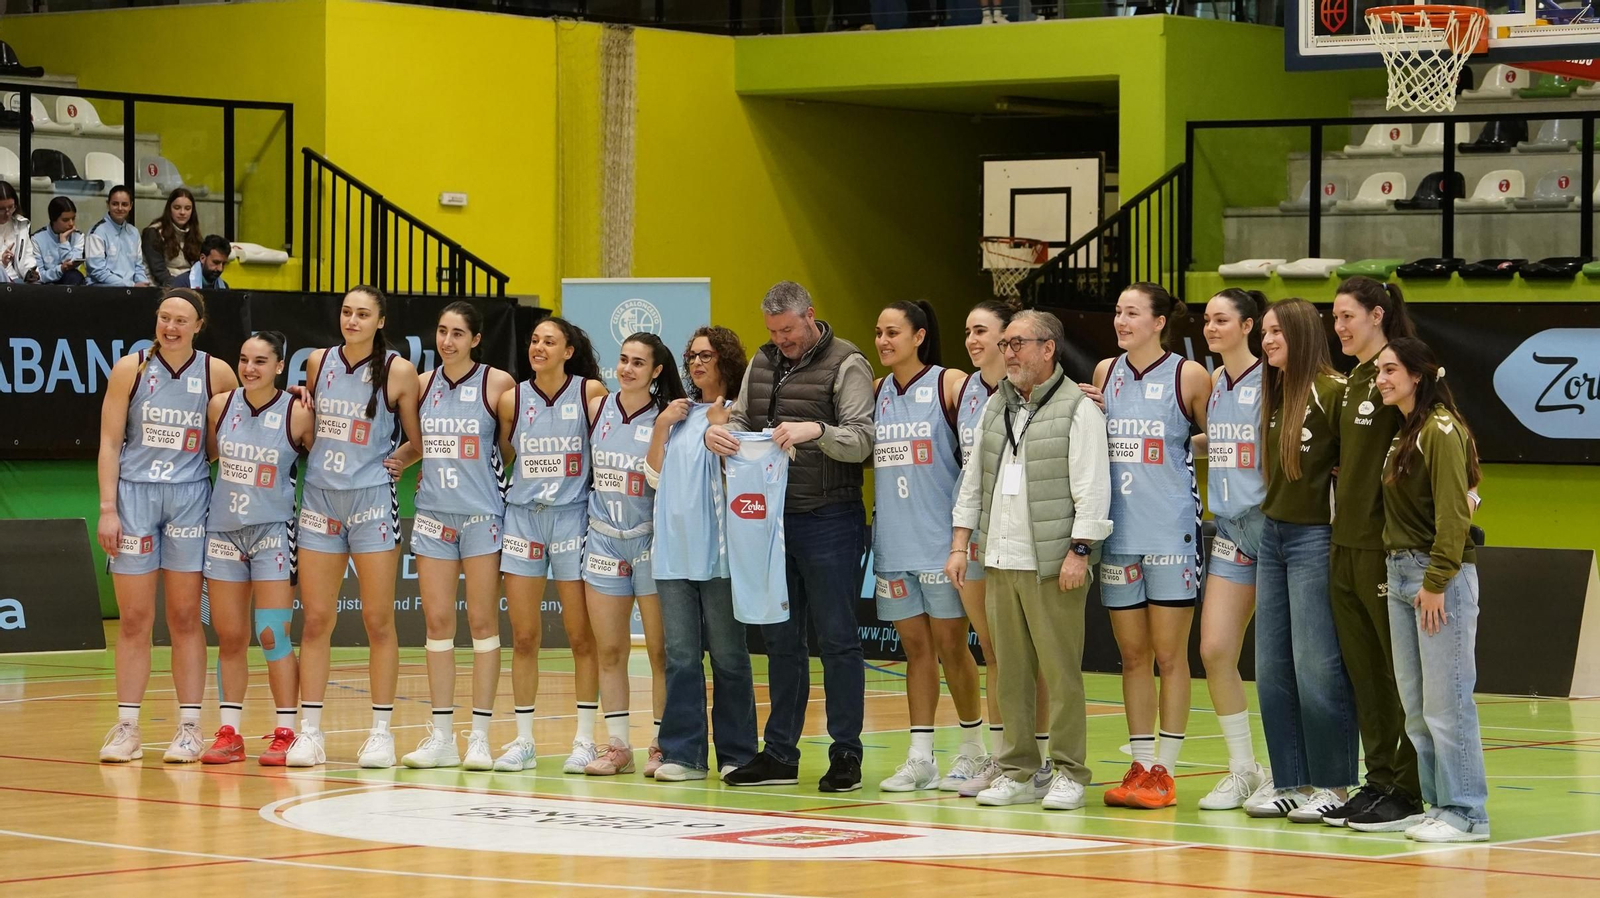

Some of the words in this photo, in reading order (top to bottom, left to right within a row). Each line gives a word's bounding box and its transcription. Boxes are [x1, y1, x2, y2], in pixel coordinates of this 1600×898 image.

[624, 301, 660, 325] BALONCESTO
[0, 338, 154, 394] BAN
[141, 401, 202, 427] femxa
[318, 418, 347, 429] ONCELLO
[420, 413, 479, 434] femxa
[875, 421, 931, 440] emxa
[1107, 418, 1165, 437] emxa
[145, 427, 181, 438] CONCELLO
[158, 436, 175, 444] VIGO
[219, 435, 279, 464] femxa
[520, 432, 582, 453] femxa
[1108, 442, 1139, 450] ONCELLO
[1209, 447, 1233, 455] ONCELLO
[323, 450, 346, 473] 29
[148, 460, 174, 480] 52
[231, 470, 247, 480] VIGO
[438, 468, 458, 488] 15
[1120, 471, 1133, 495] 2
[897, 476, 909, 499] 8
[1222, 478, 1228, 502] 1
[229, 492, 250, 515] 32
[607, 500, 622, 522] 11
[740, 499, 765, 514] Zorka
[309, 520, 322, 528] VIGO
[210, 541, 239, 552] CONCELLO
[509, 545, 523, 553] VIGO
[1213, 539, 1234, 551] ONCELLO
[1217, 547, 1231, 556] VIGO
[218, 549, 234, 557] VIGO
[1142, 555, 1188, 566] ecalvi
[589, 557, 616, 567] CONCELLO
[597, 564, 612, 572] VIGO
[393, 597, 410, 610] nd
